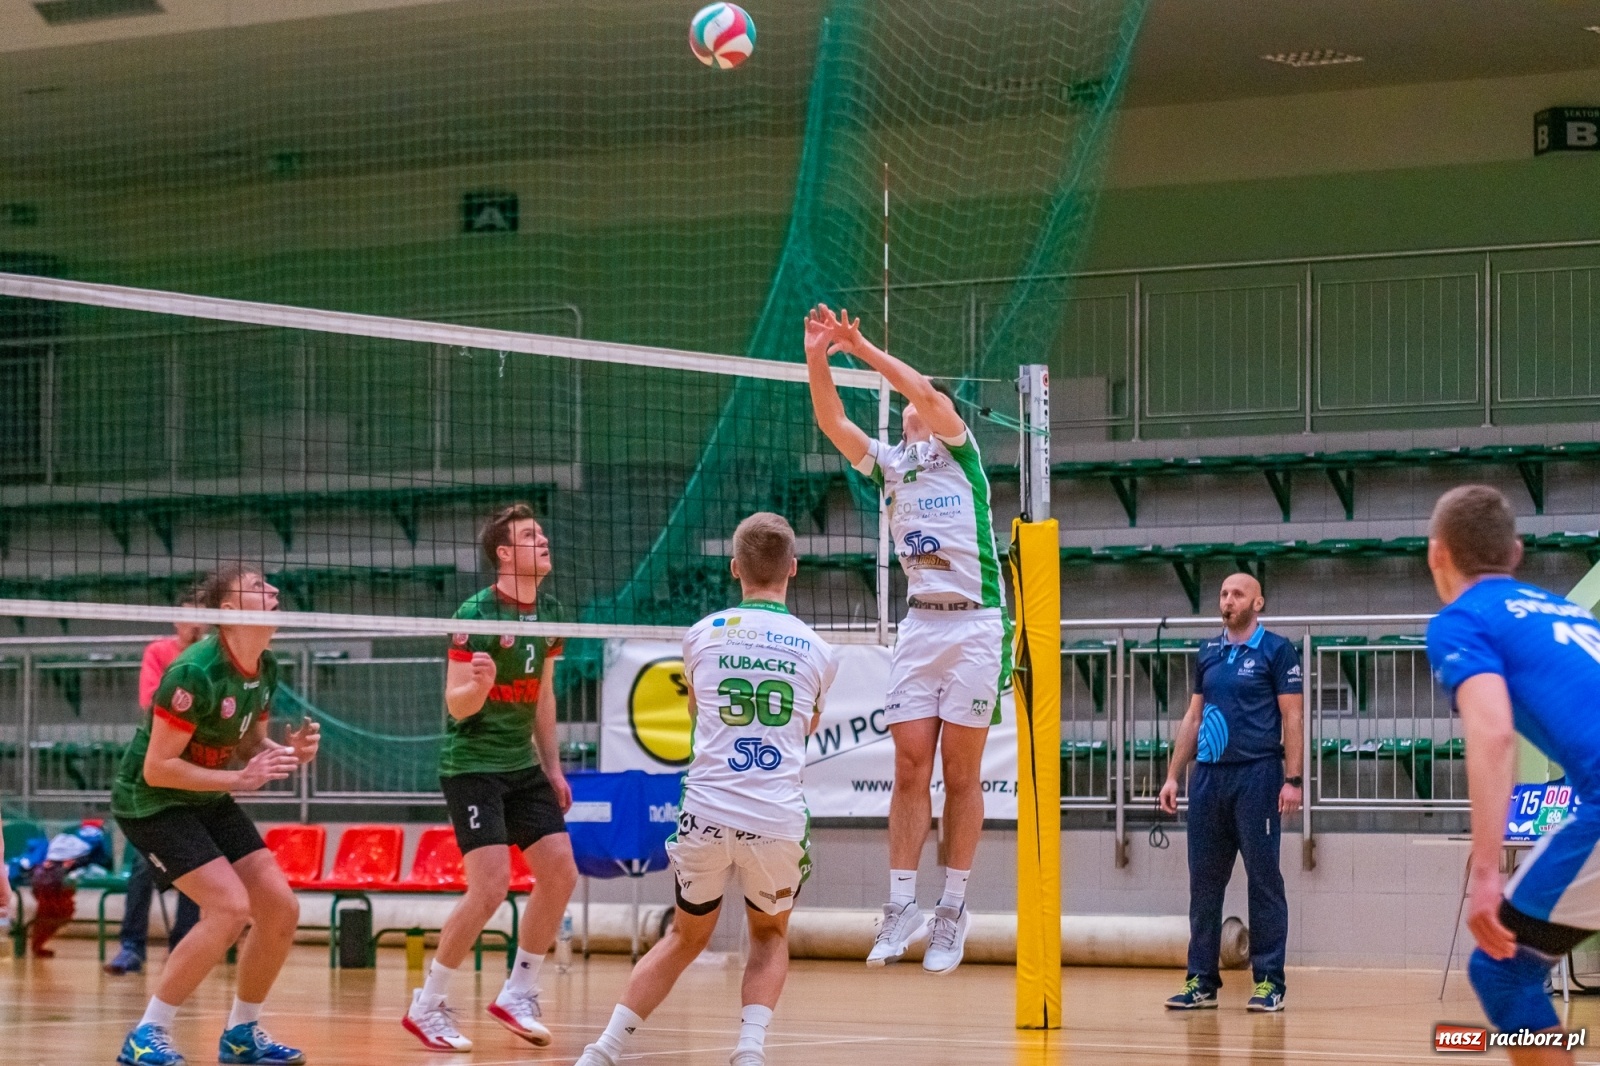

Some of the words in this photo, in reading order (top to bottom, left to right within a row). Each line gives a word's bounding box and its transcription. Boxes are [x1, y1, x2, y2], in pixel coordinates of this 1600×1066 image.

[1537, 125, 1549, 150] B
[1566, 121, 1599, 147] B
[472, 206, 509, 230] A
[727, 628, 811, 651] eco-team
[524, 643, 535, 674] 2
[718, 655, 797, 675] KUBACKI
[717, 677, 794, 727] 30
[239, 711, 253, 740] 4
[815, 724, 841, 755] W
[727, 737, 782, 772] STO
[1520, 790, 1542, 816] 15
[468, 805, 481, 830] 2
